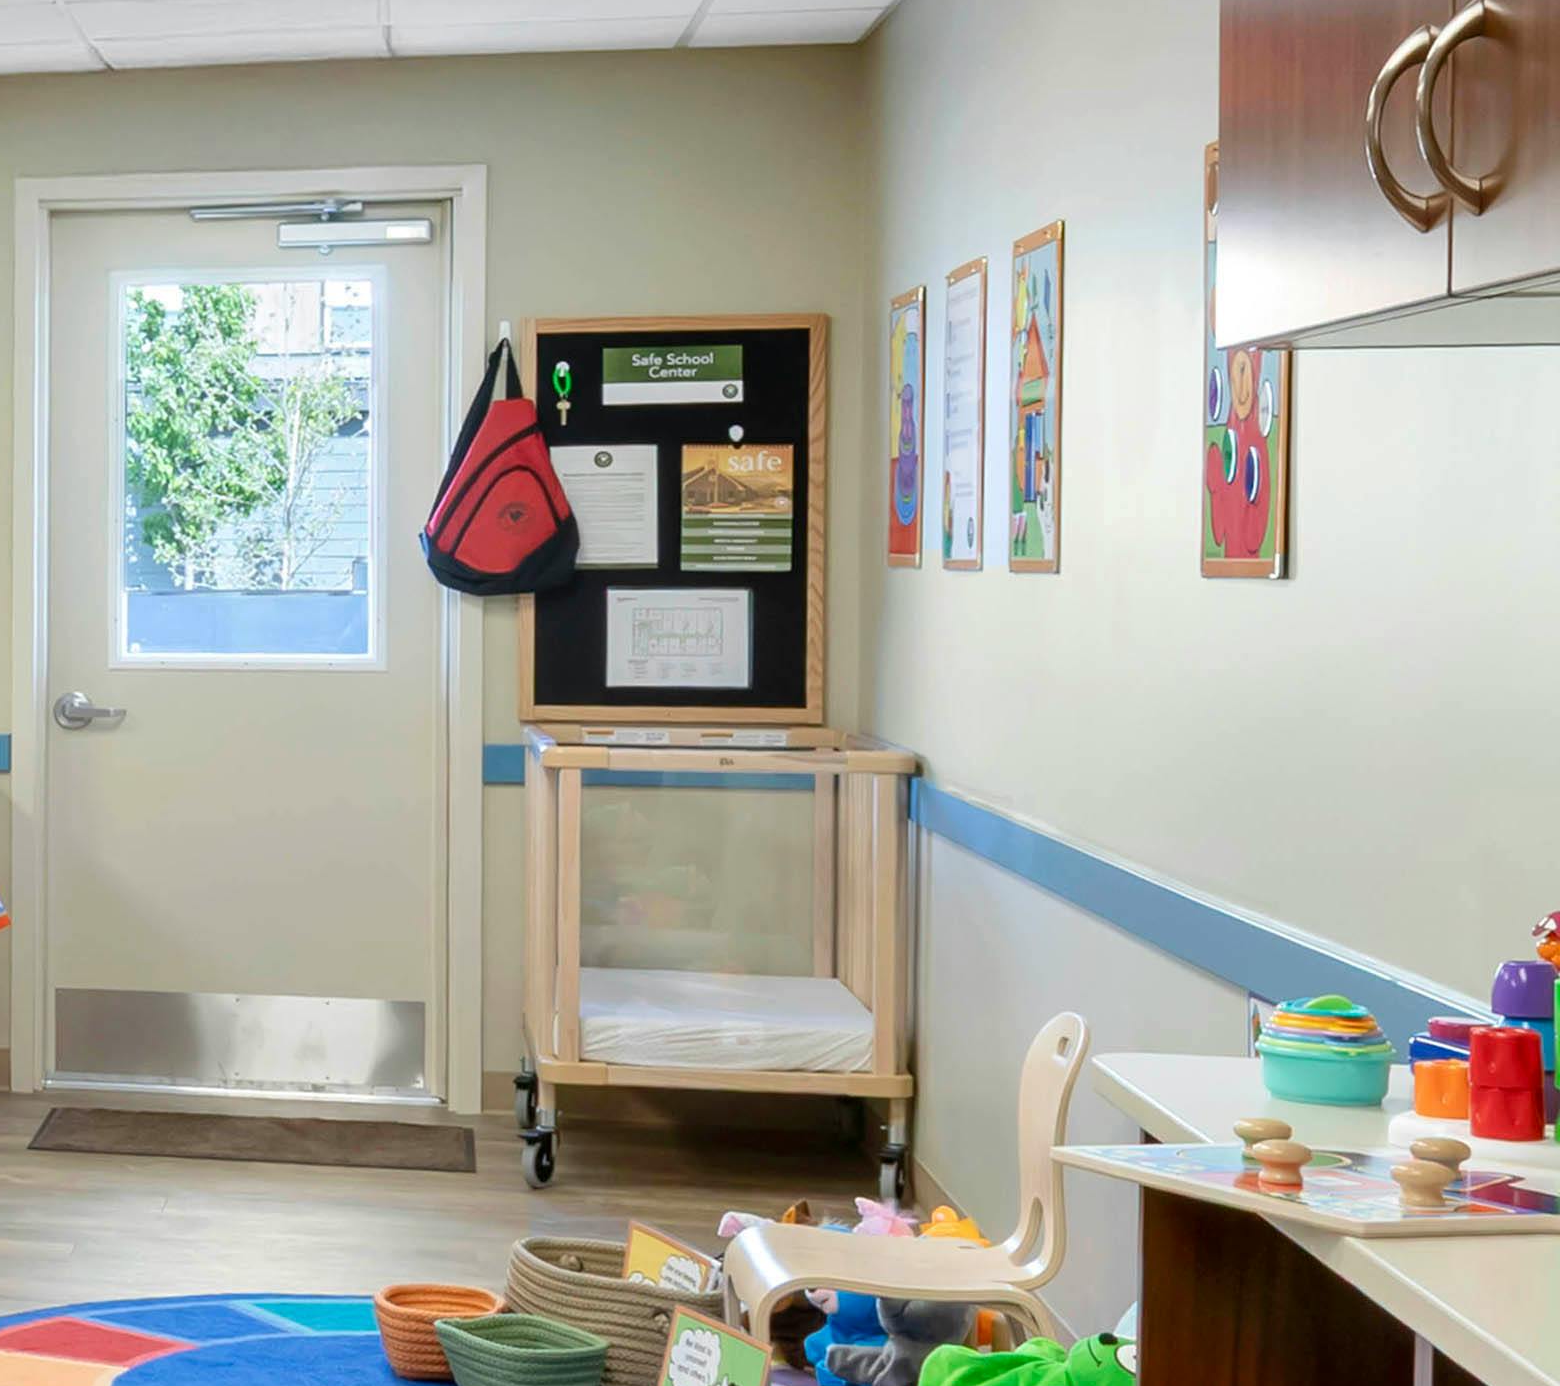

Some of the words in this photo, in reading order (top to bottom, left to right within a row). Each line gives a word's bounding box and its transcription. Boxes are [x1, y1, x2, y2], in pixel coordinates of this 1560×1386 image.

[631, 353, 663, 366] Safe
[666, 352, 714, 365] School
[648, 366, 699, 379] Center
[728, 450, 782, 472] safe
